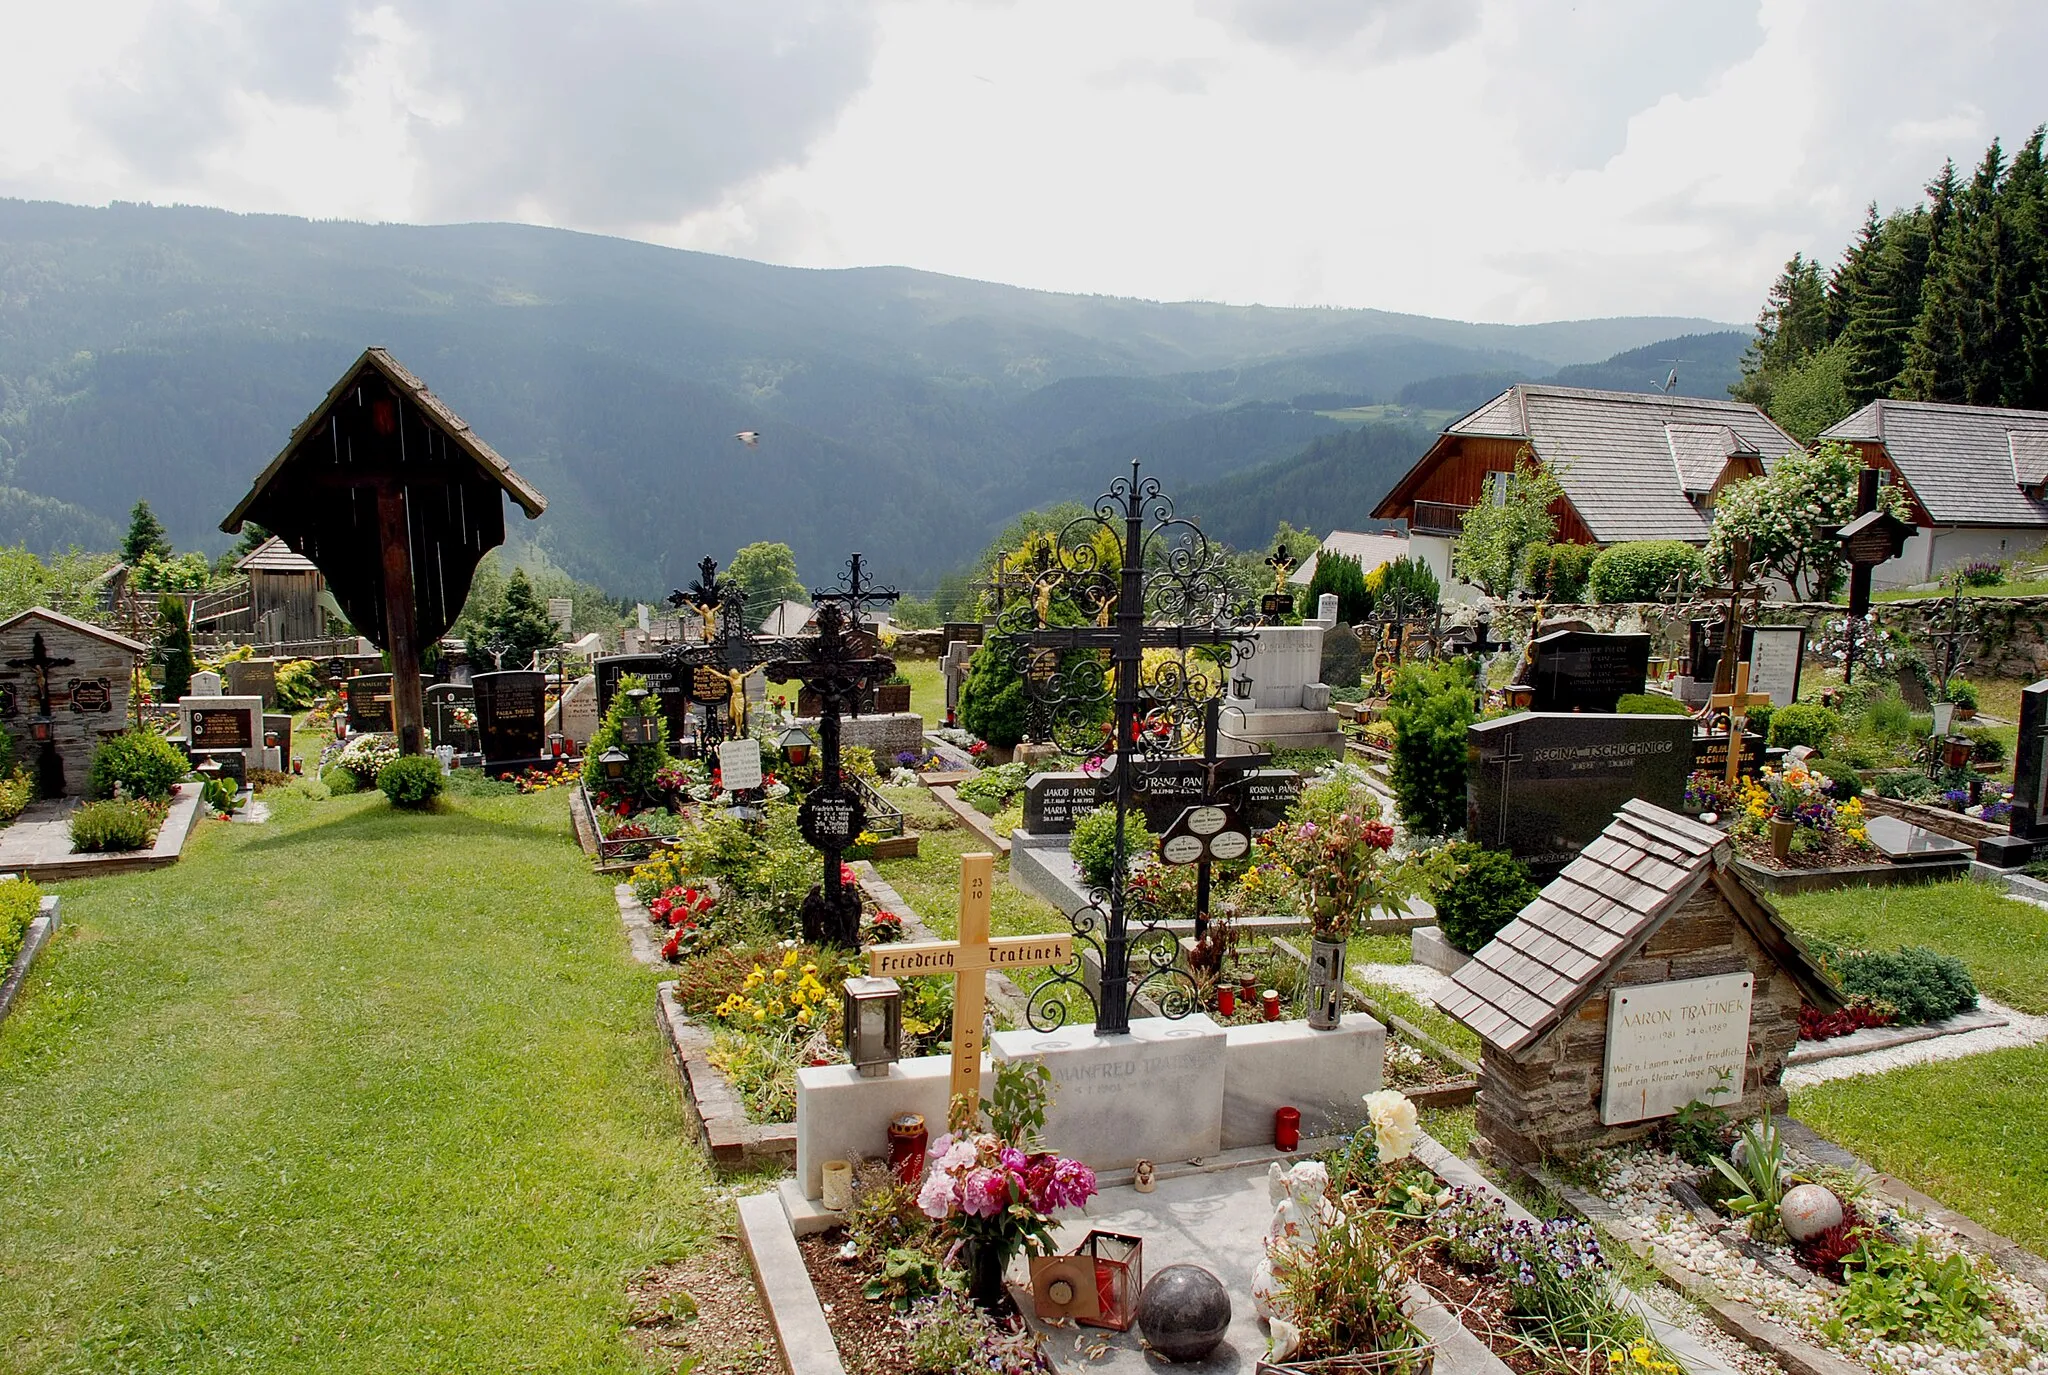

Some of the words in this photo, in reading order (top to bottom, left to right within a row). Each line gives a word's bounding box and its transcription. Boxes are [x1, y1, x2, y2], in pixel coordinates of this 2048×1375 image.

[1695, 752, 1755, 764] TSCHUNIK
[1043, 788, 1069, 797] JAKOB
[1073, 787, 1096, 796] PANSI
[1249, 785, 1275, 794] ROSINA
[1043, 805, 1067, 815] MARIA
[972, 878, 983, 887] 23
[972, 890, 983, 899] 10
[881, 952, 954, 971] Friedrich
[988, 944, 1062, 962] Tratinek
[1620, 1010, 1672, 1028] AARON
[1680, 999, 1744, 1020] TRATINEK
[1612, 1063, 1632, 1074] Wolf
[1672, 1054, 1703, 1065] weiden
[1706, 1047, 1740, 1062] friedlich
[1057, 1060, 1135, 1082] MANFRED
[1617, 1078, 1633, 1089] und
[1635, 1075, 1649, 1085] ein
[1651, 1070, 1679, 1083] kleiner
[1682, 1069, 1705, 1080] Junge
